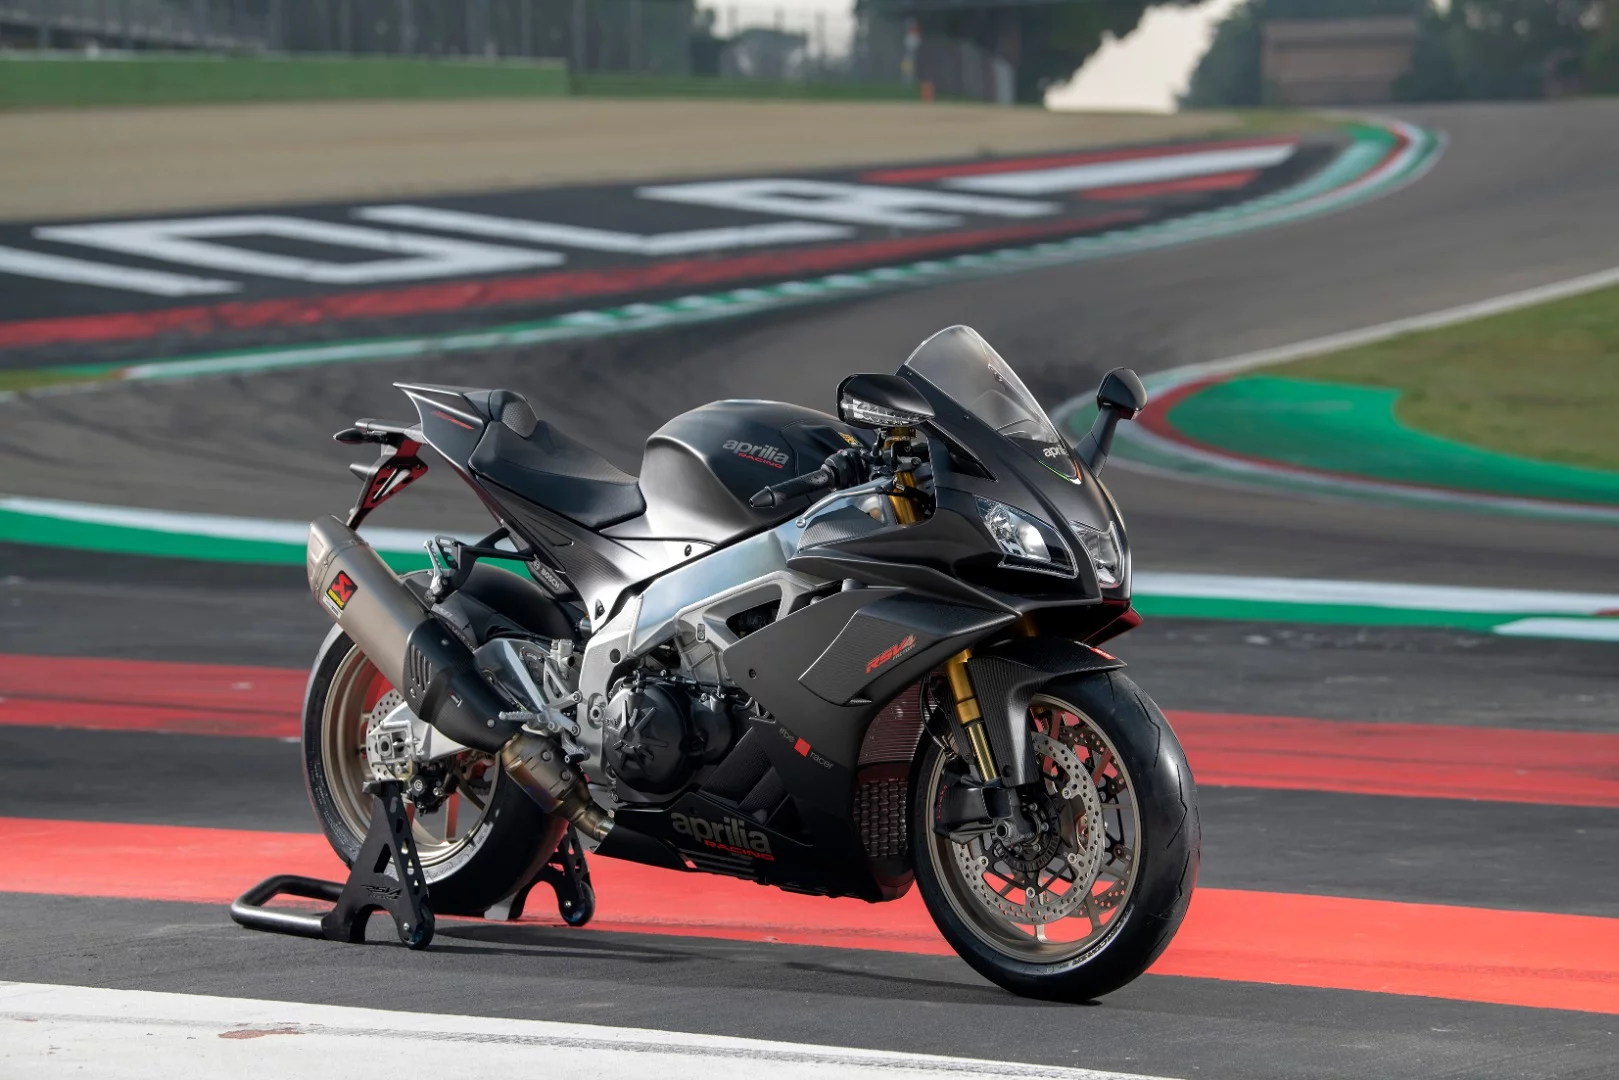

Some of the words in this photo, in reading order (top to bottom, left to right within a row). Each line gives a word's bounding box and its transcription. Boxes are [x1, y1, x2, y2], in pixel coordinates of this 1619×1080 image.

[722, 439, 789, 465] aprilia
[738, 452, 784, 469] RACING
[541, 568, 560, 589] BOSCH
[865, 633, 917, 674] RSV4
[810, 751, 835, 769] racer
[670, 812, 773, 854] aprilia
[703, 839, 775, 862] RACING
